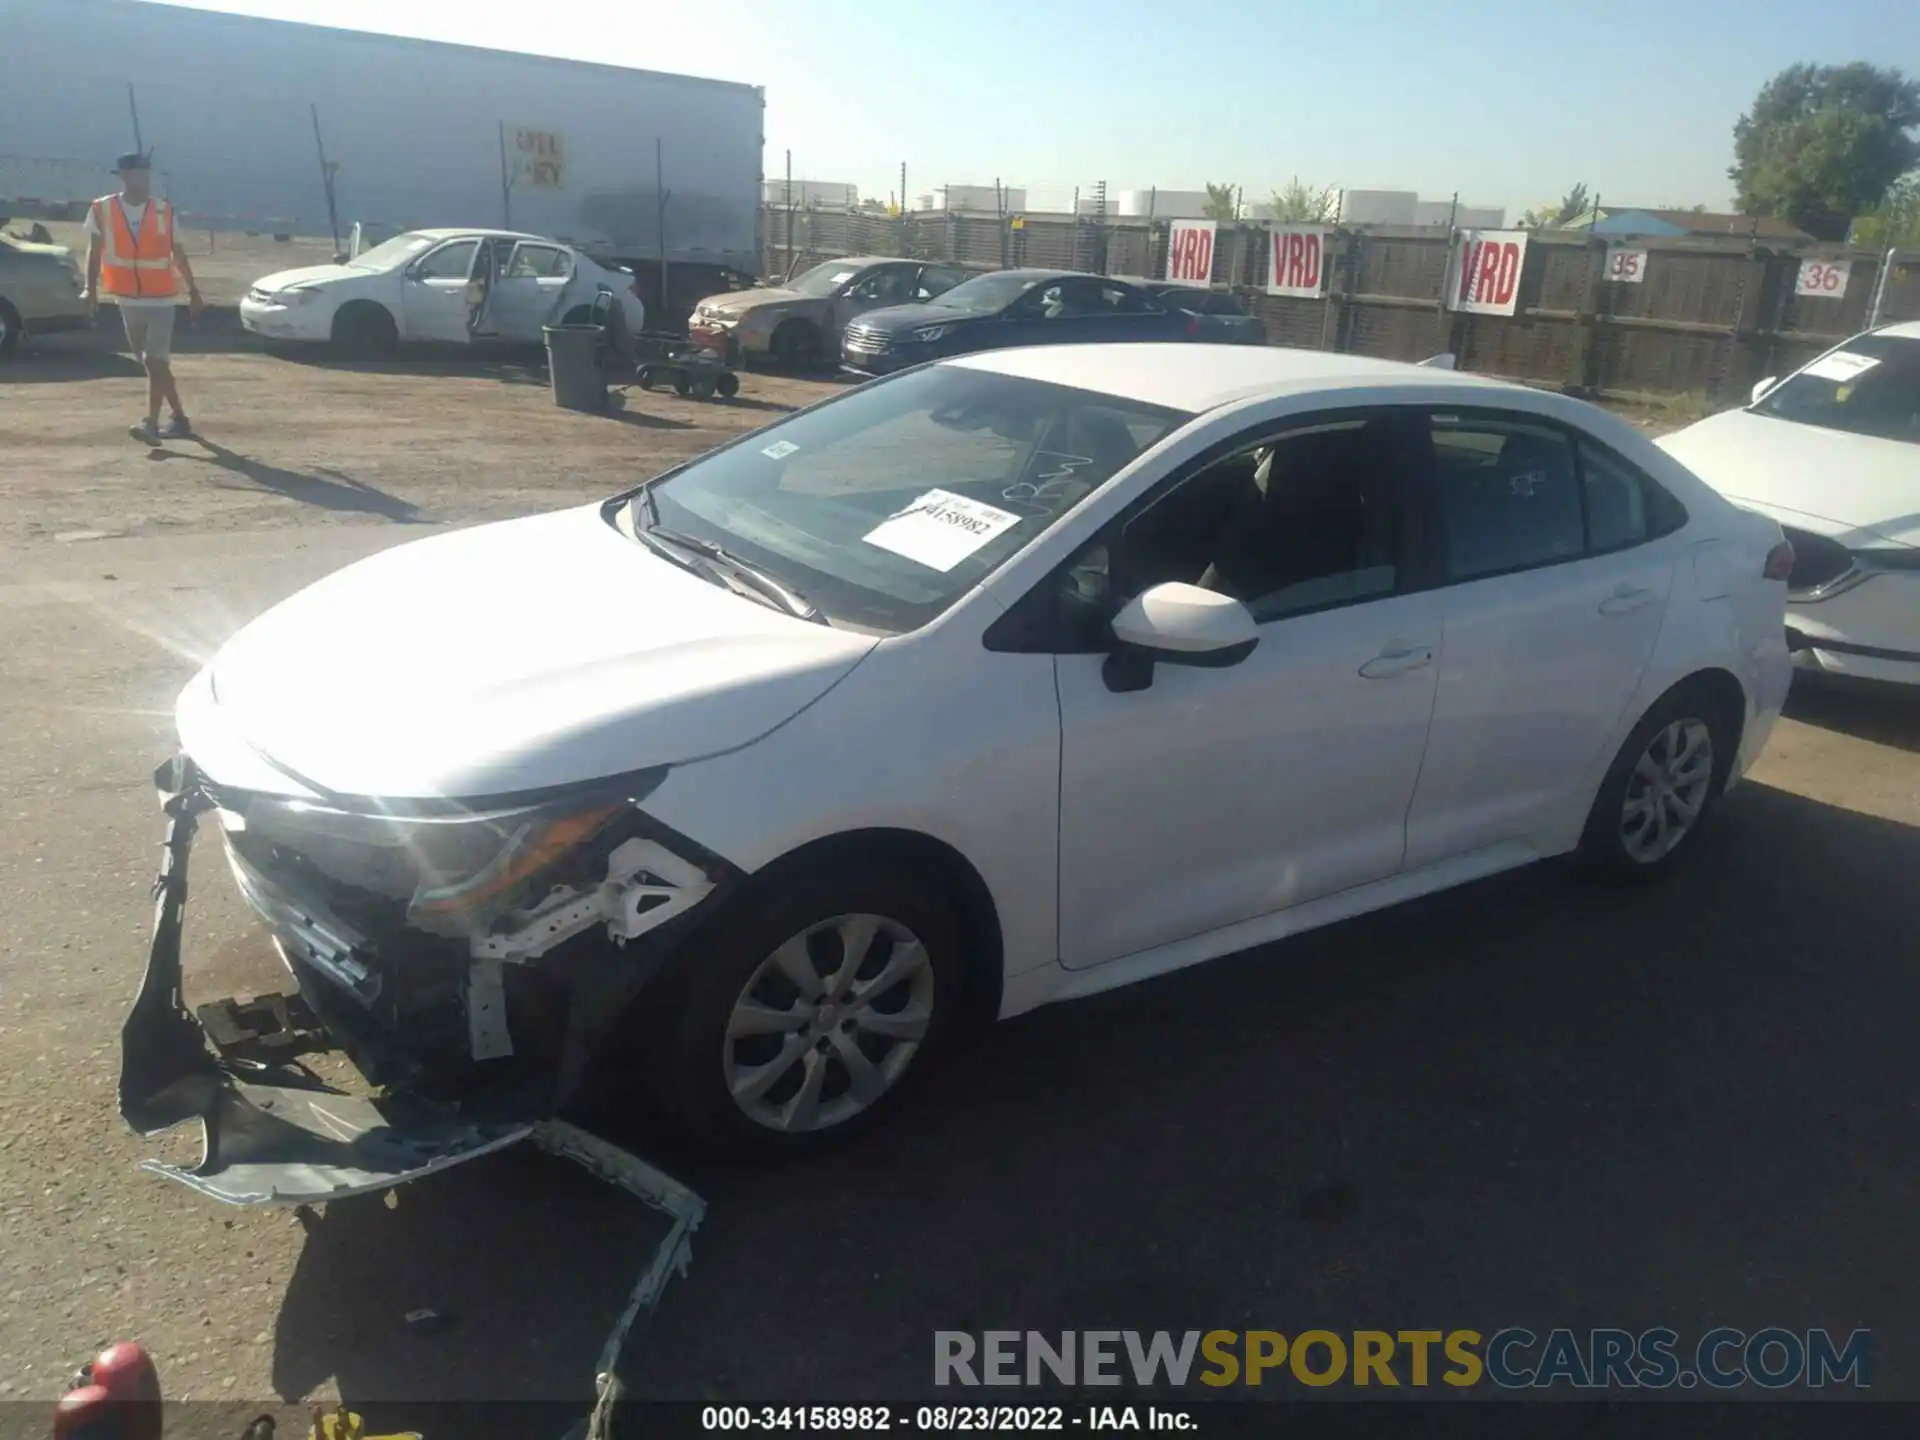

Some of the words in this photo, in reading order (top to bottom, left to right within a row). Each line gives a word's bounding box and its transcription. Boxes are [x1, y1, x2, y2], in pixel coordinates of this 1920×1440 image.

[1171, 228, 1212, 281] VRD
[1274, 232, 1320, 288] VRD
[1460, 240, 1520, 305] VRD
[1611, 252, 1638, 275] 35
[1804, 263, 1843, 291] 36
